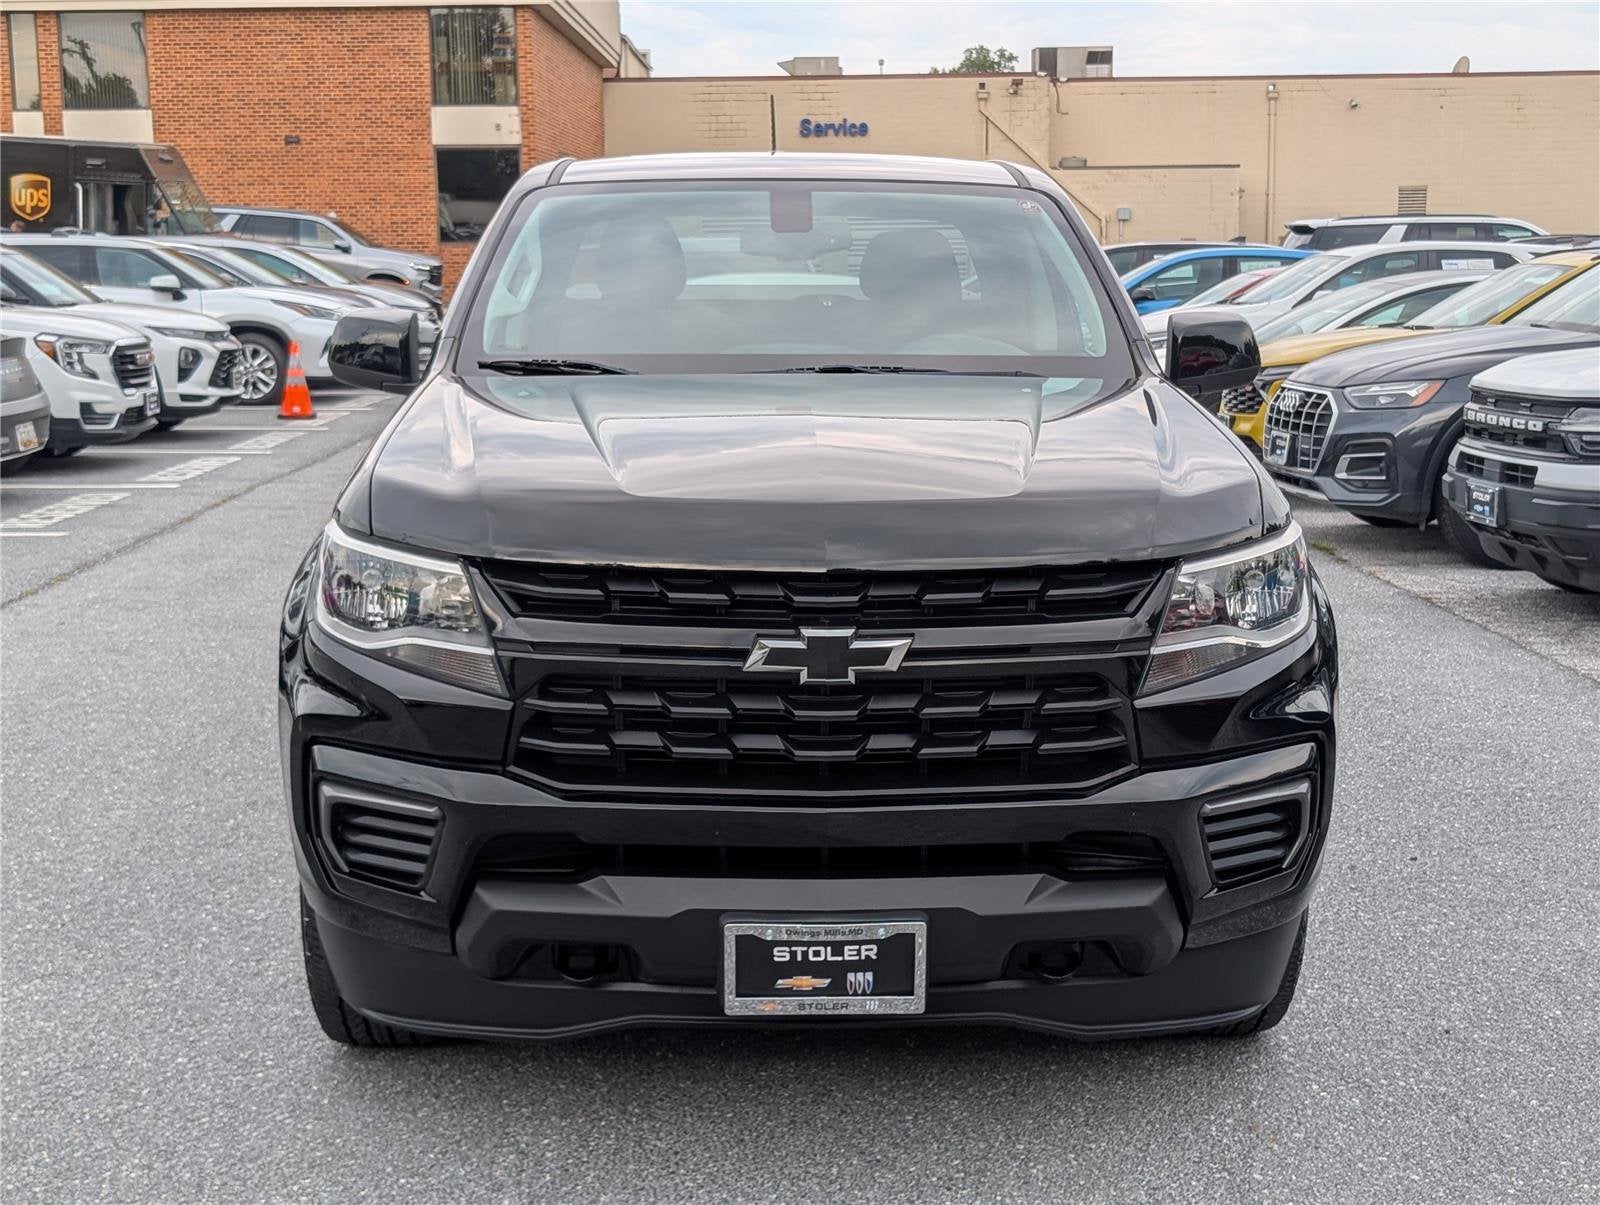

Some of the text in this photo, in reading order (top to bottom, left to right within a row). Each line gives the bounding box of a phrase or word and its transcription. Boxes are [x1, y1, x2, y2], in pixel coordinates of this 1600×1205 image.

[800, 118, 868, 138] Service
[14, 188, 49, 214] ups
[1467, 409, 1543, 432] BRONCO
[785, 928, 820, 938] Owings
[773, 944, 878, 962] STOLER
[799, 1002, 849, 1011] STOLER
